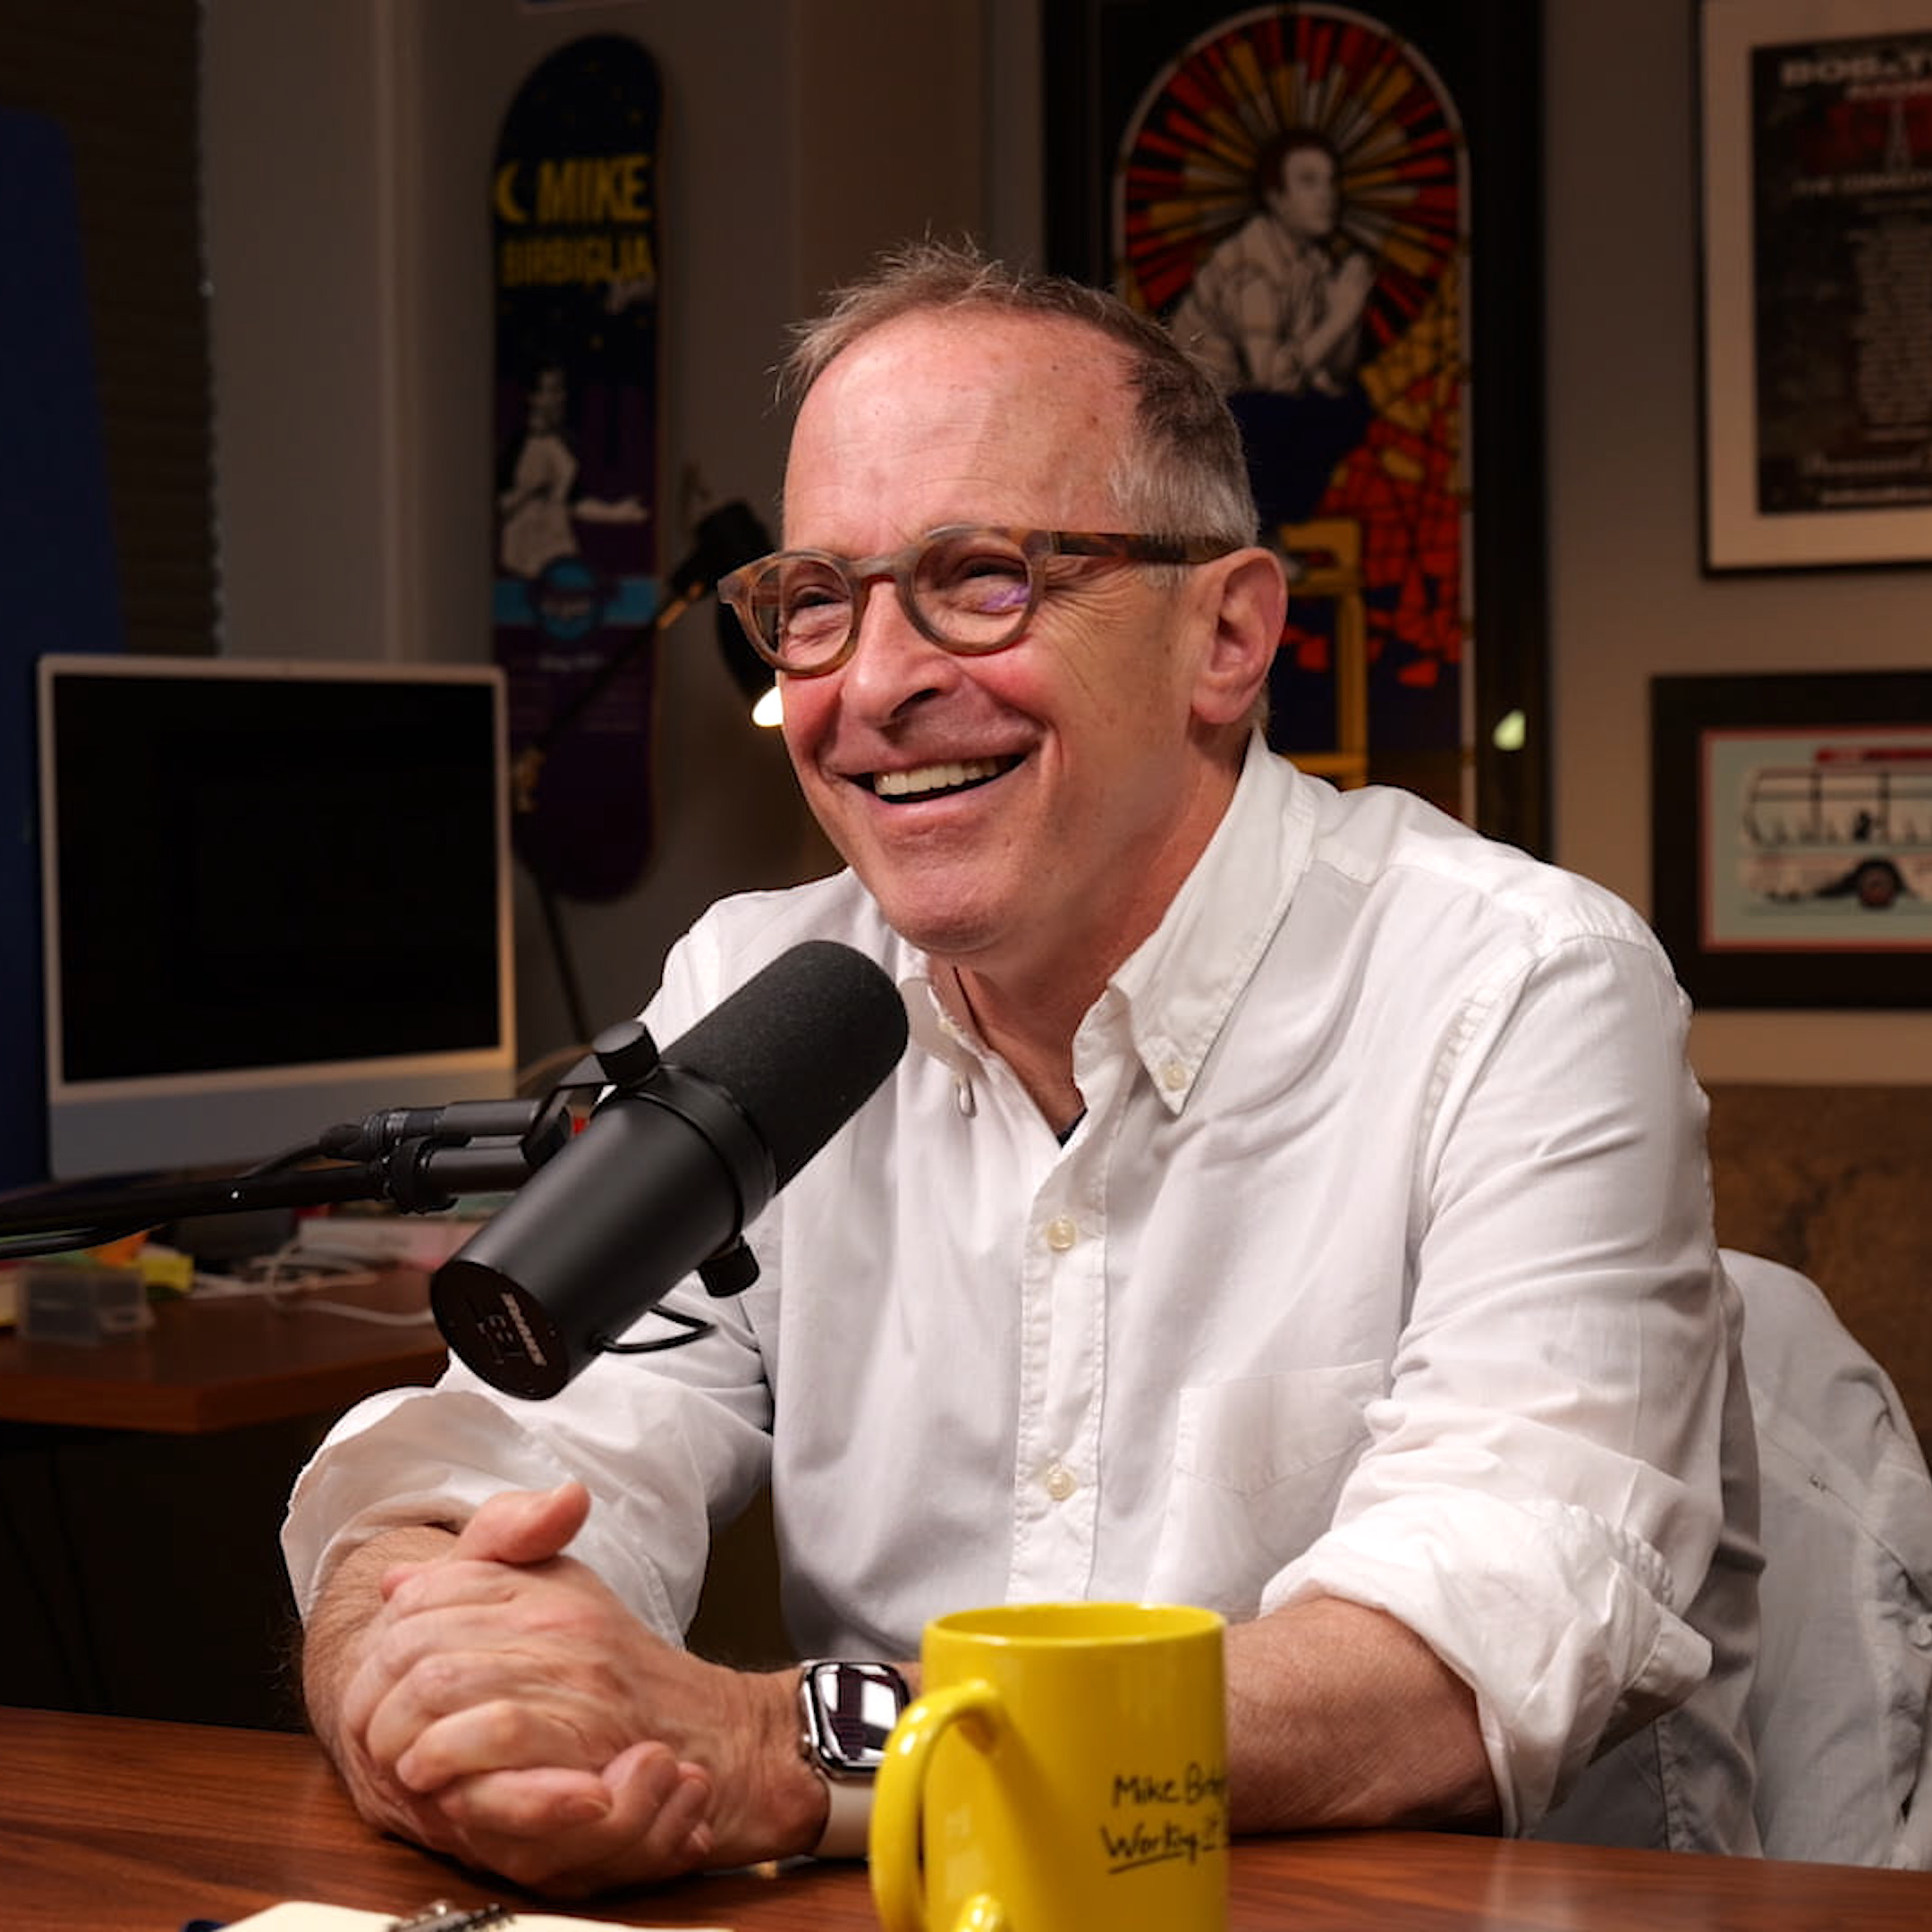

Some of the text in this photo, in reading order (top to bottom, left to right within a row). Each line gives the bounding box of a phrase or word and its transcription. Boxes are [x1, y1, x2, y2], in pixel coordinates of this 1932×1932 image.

[537, 154, 654, 224] MIKE
[1111, 1774, 1181, 1809] Mike
[1099, 1818, 1199, 1868] Working
